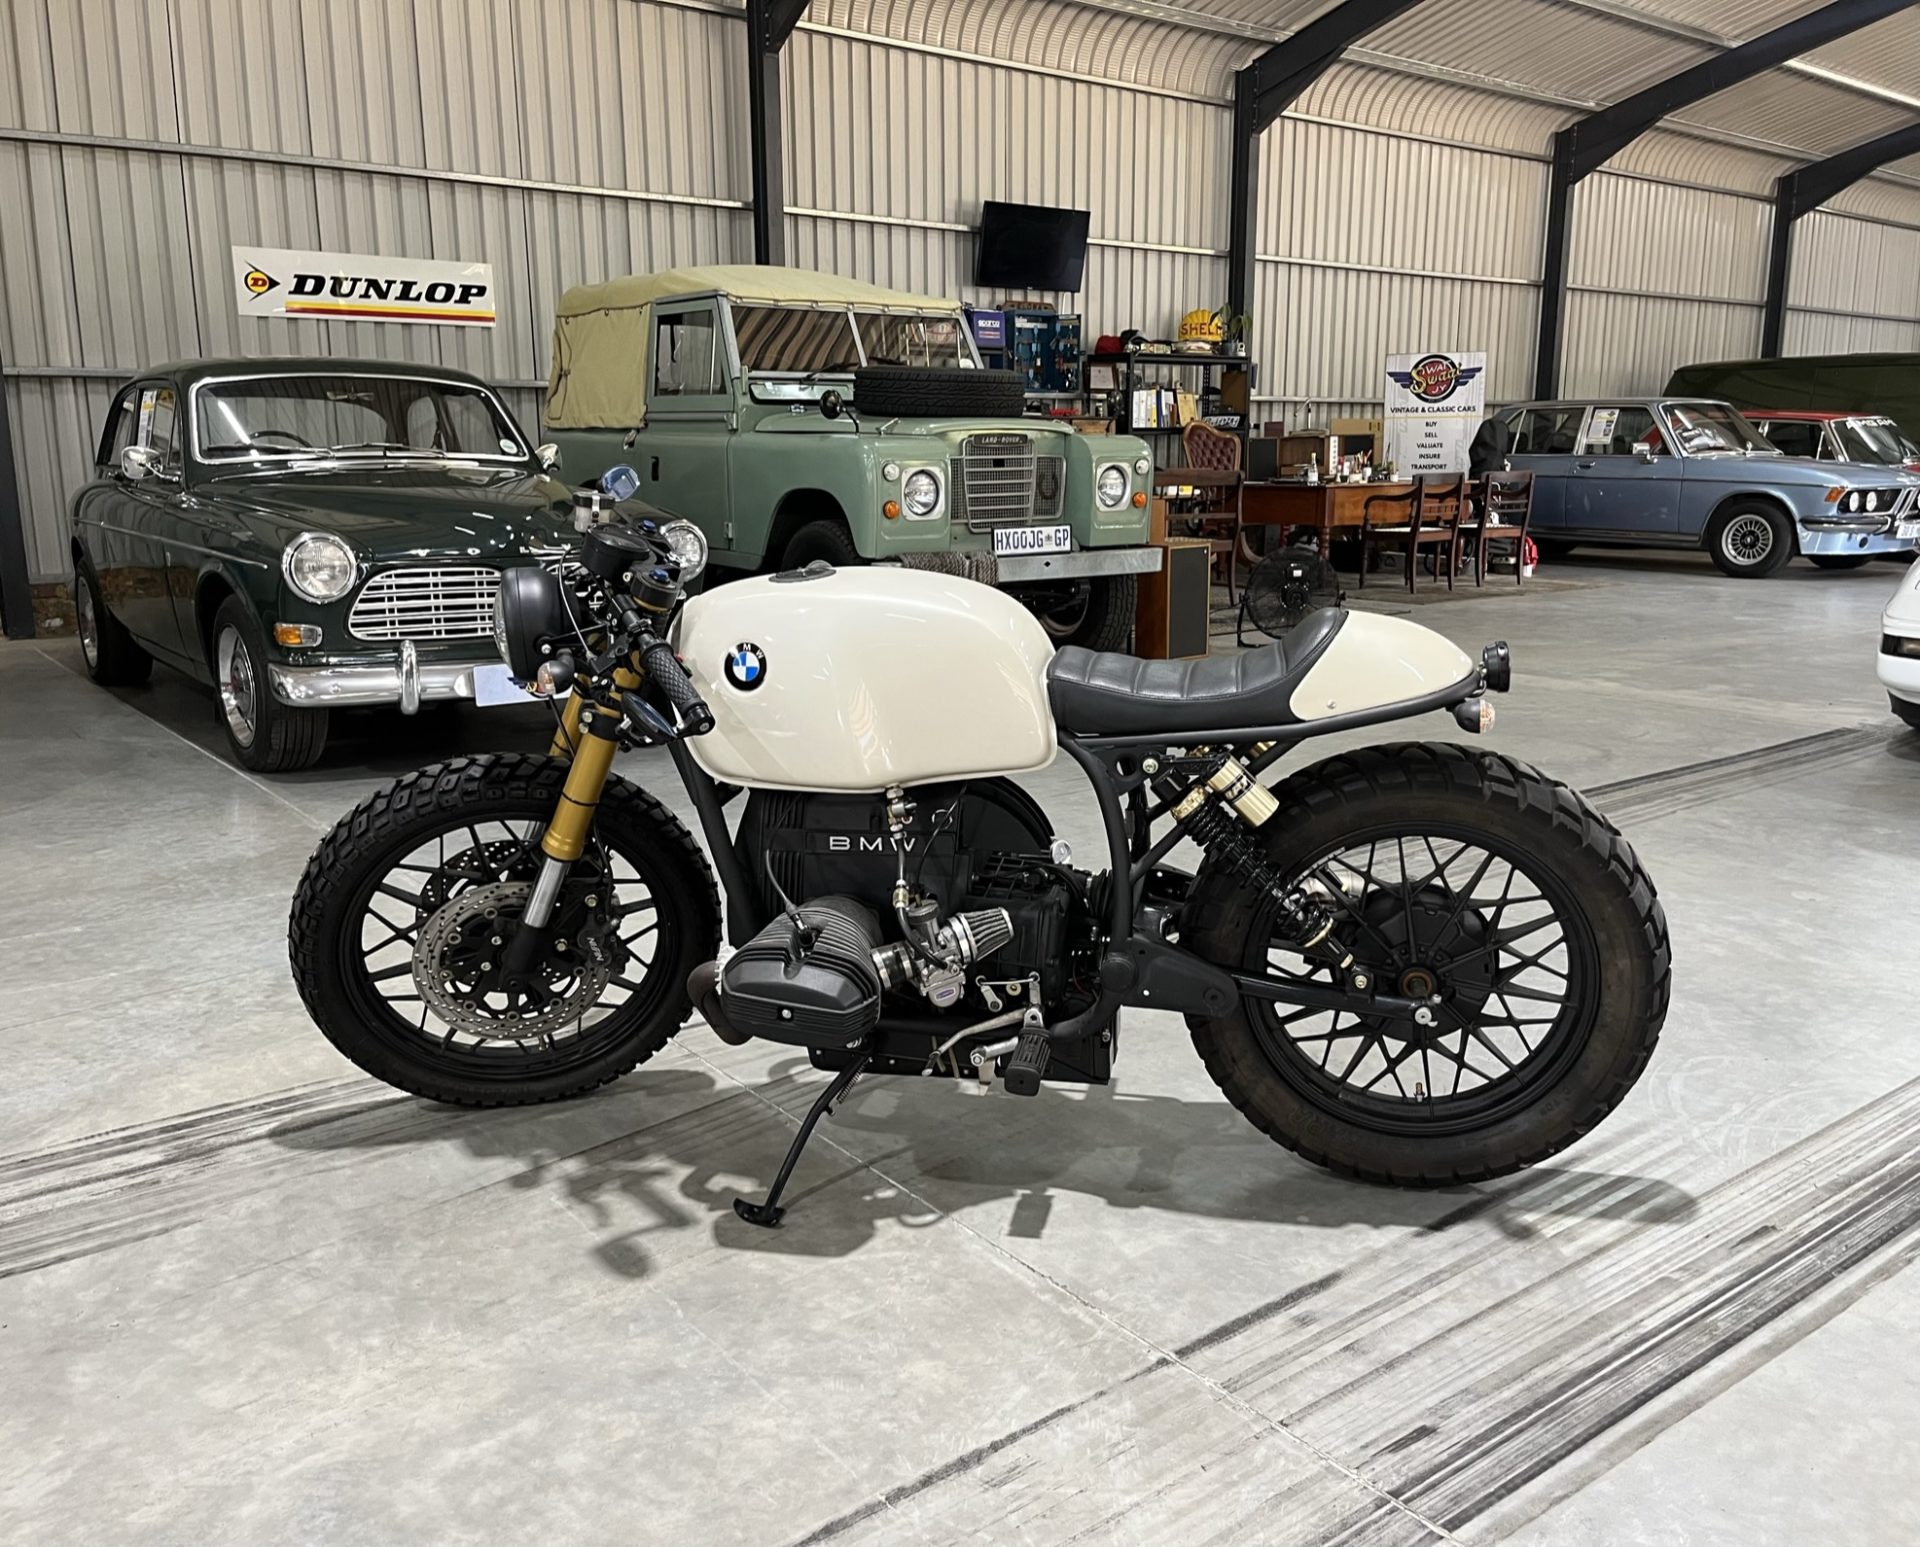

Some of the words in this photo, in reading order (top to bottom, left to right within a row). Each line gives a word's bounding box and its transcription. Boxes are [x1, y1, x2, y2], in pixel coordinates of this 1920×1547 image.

[288, 273, 487, 305] DUNLOP
[1054, 528, 1069, 547] GP
[829, 836, 916, 852] BMW
